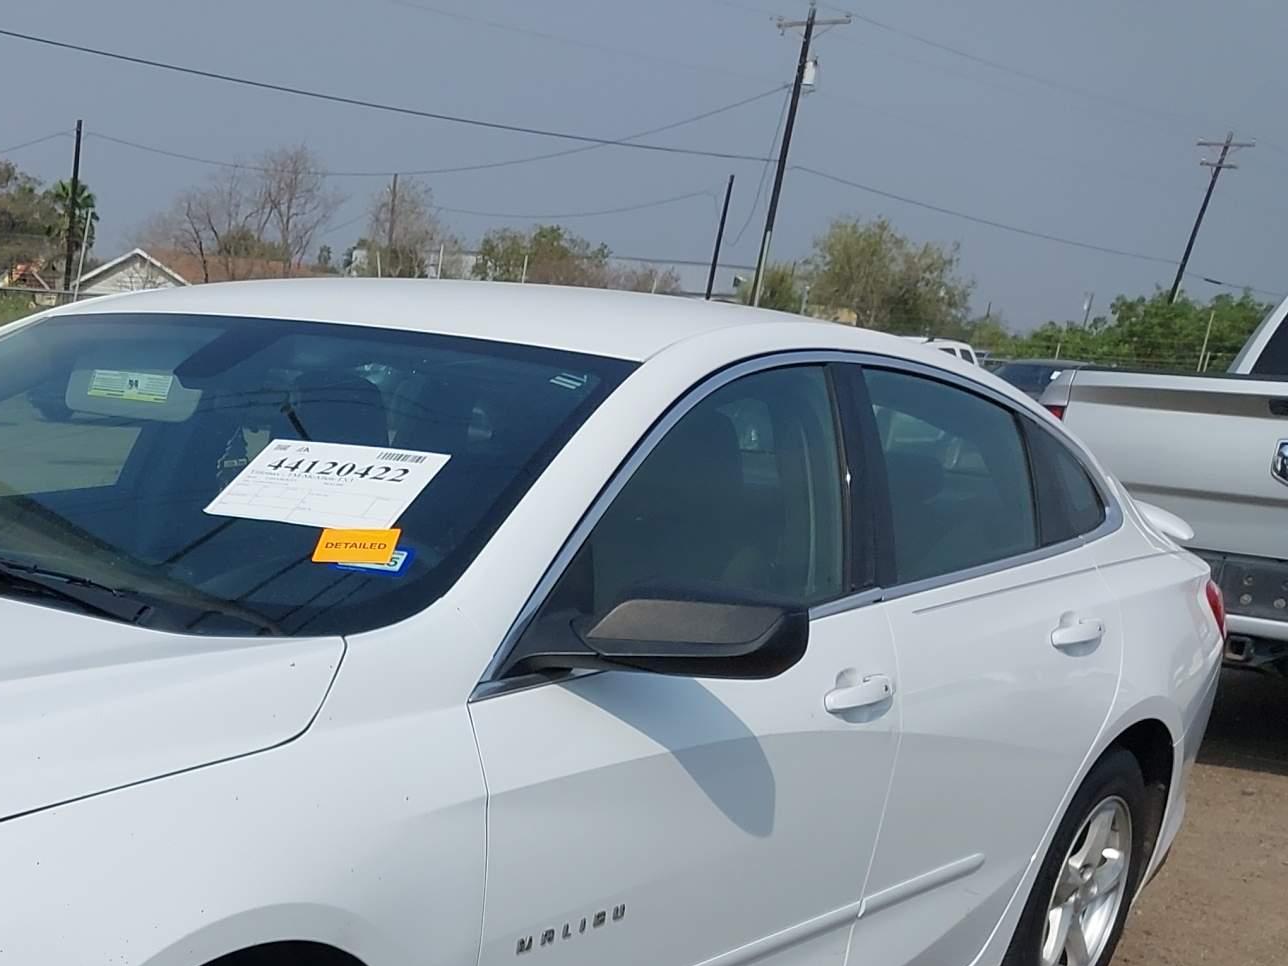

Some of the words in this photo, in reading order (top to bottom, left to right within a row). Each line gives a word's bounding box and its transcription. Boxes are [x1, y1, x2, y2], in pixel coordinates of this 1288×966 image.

[268, 457, 410, 482] 44120422
[325, 541, 388, 551] DETAILED
[516, 903, 626, 956] MALIBU
